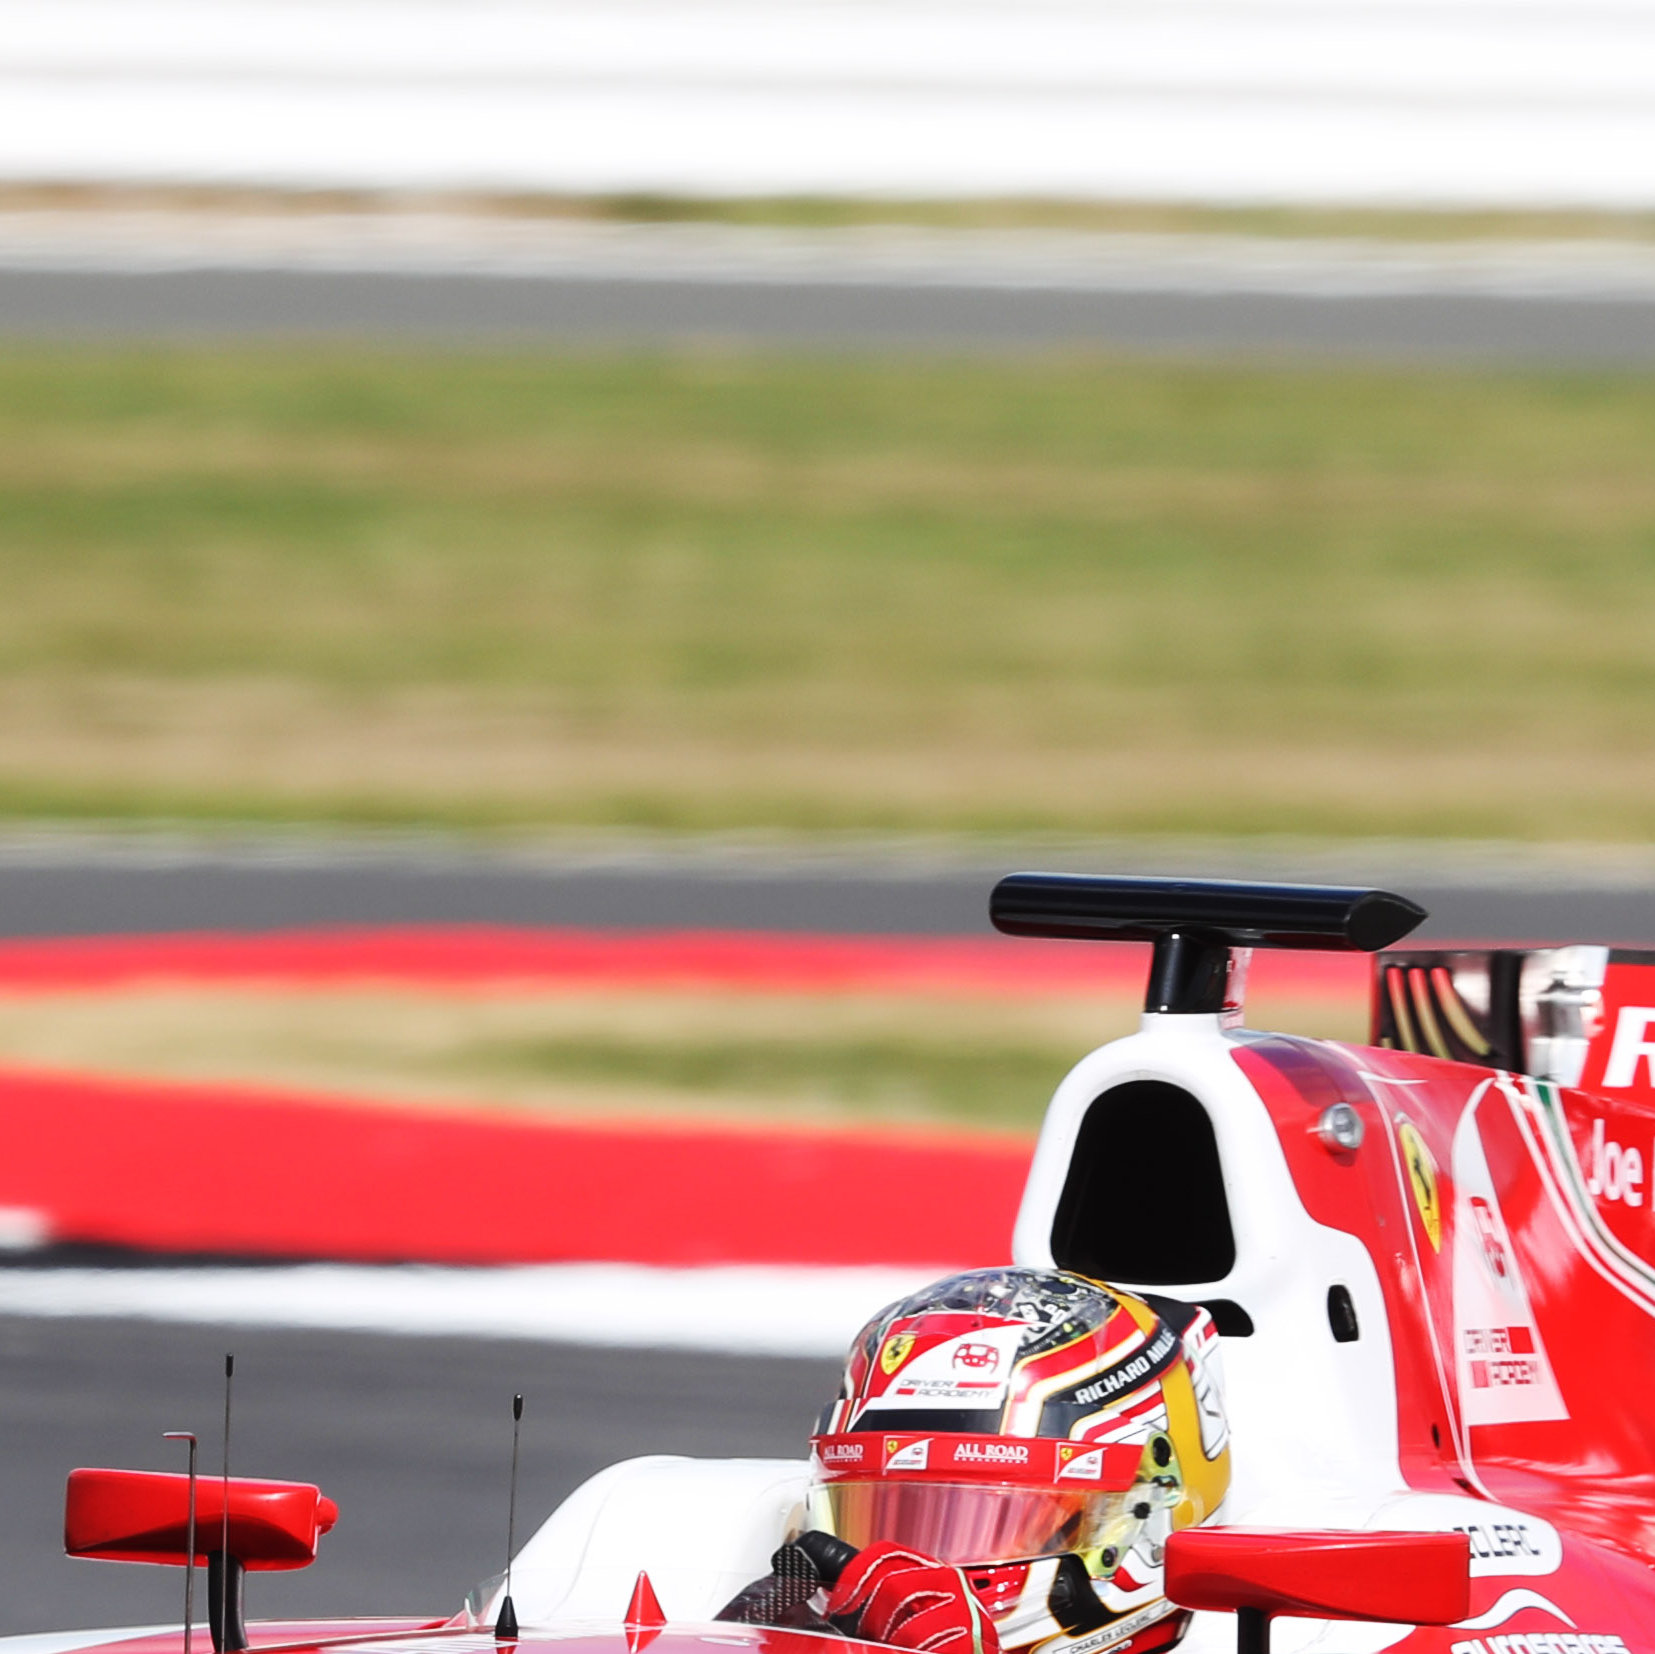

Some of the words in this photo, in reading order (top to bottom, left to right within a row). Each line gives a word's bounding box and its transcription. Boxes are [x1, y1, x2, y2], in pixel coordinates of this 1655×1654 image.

[1586, 1118, 1643, 1208] Joe
[1074, 1355, 1151, 1405] RICHARD
[954, 1443, 982, 1457] ALL
[985, 1444, 1029, 1458] ROAD
